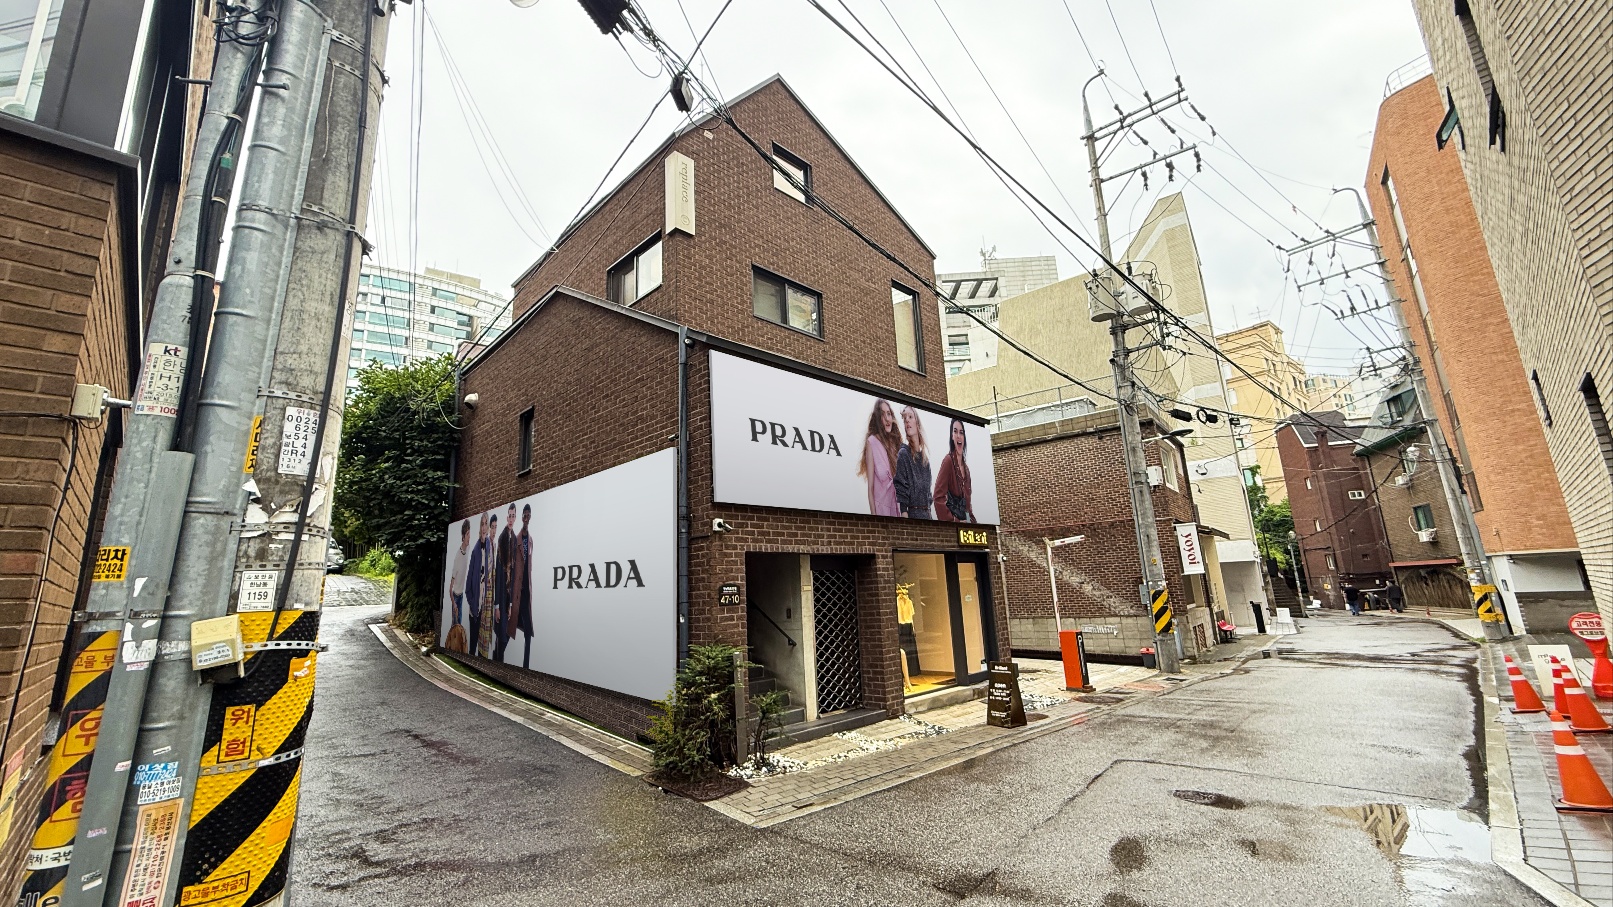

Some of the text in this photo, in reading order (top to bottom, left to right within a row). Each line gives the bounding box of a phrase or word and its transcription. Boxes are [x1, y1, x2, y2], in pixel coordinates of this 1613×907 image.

[163, 345, 182, 357] kt
[159, 406, 178, 415] 100
[748, 417, 843, 458] PRADA
[1180, 532, 1201, 566] yoyoi
[552, 559, 646, 590] PRADA
[247, 591, 269, 601] 1159
[720, 594, 740, 604] 47-10
[224, 707, 251, 758] 위험
